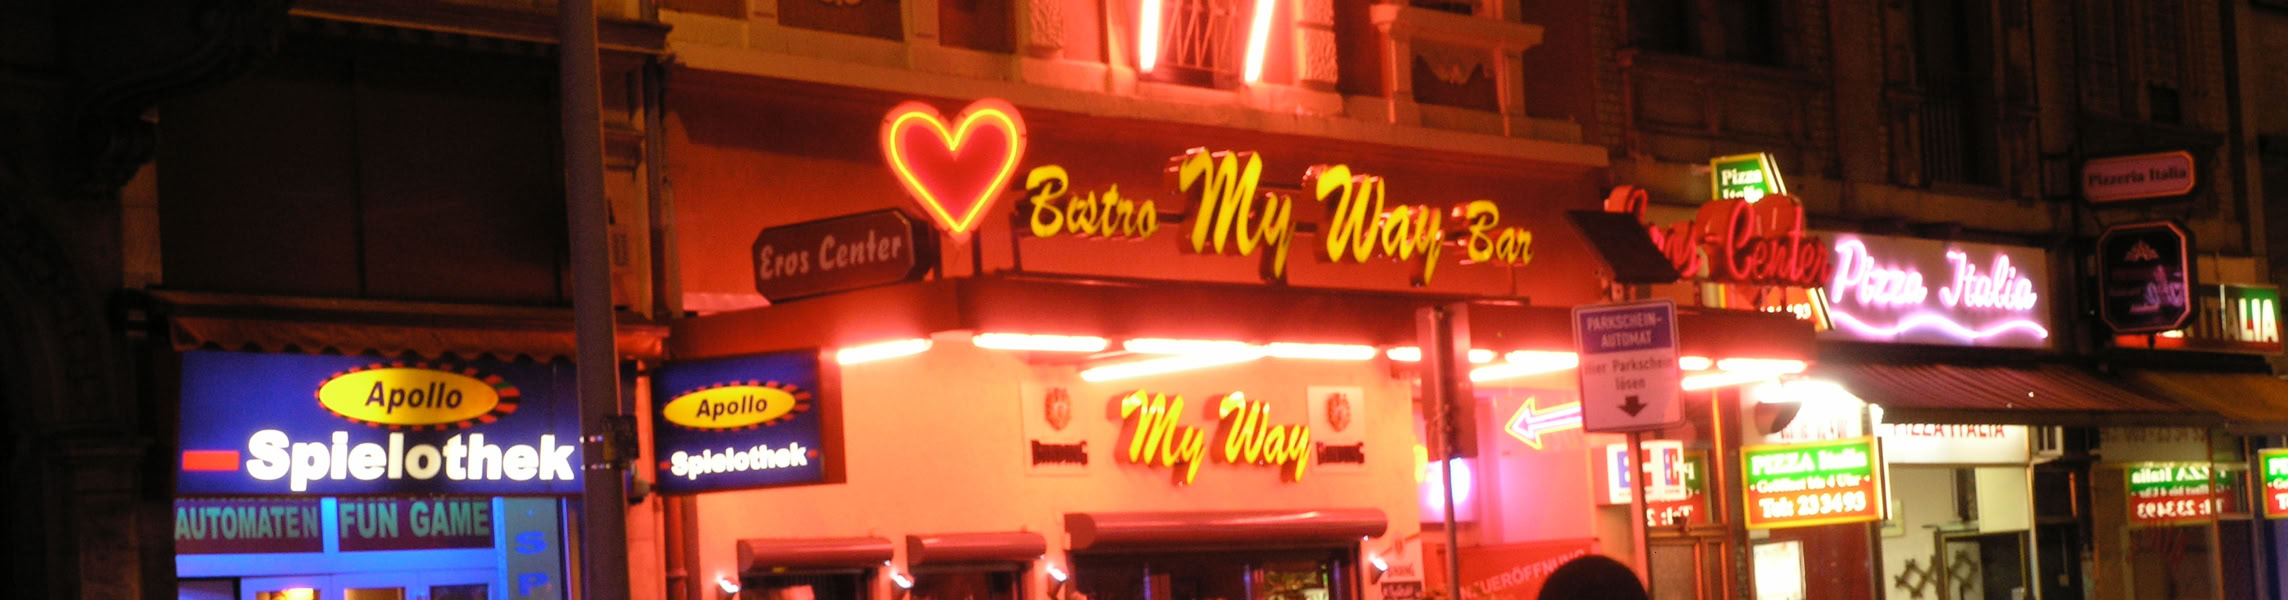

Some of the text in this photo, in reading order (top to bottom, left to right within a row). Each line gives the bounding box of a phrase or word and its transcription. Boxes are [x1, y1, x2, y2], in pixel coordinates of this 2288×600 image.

[1722, 168, 1763, 186] Pizza
[2088, 166, 2187, 188] Pizzeria Italia
[1025, 149, 1534, 284] Bistro My Way Bar
[760, 228, 902, 281] Eros Center
[1833, 236, 2037, 310] Pizza Italia
[1587, 313, 1662, 331] PARKSCHEIN-
[1601, 329, 1652, 347] AUTOMAT
[365, 380, 463, 410] Apollo
[697, 395, 768, 420] Apollo
[1122, 389, 1312, 486] My Way
[247, 429, 575, 491] Spielothek
[670, 442, 807, 480] Spielothek
[1751, 453, 1815, 475] PIZZA
[174, 498, 489, 540] AUTOMATEN FUN GAME
